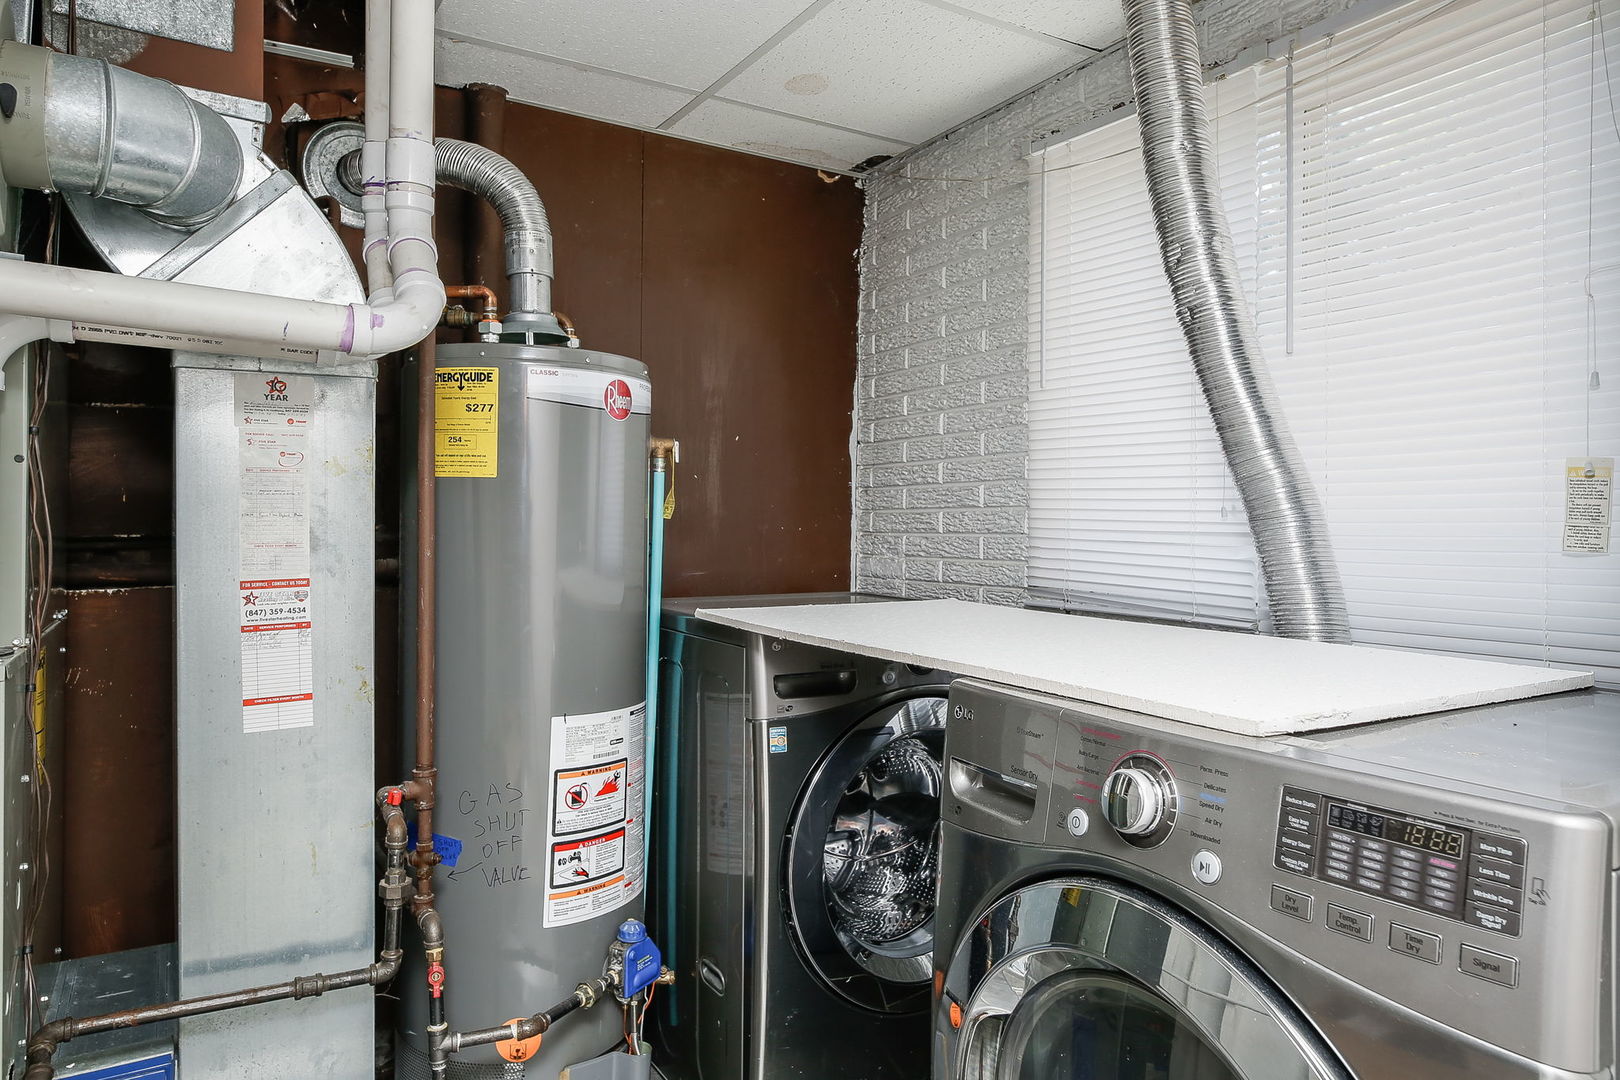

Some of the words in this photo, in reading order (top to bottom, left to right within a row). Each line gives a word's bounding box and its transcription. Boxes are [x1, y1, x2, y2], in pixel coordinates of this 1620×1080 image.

[606, 380, 632, 414] Rheem
[465, 404, 494, 412] $277
[245, 610, 266, 618] (847)
[269, 606, 306, 616] 359-4534
[588, 766, 612, 775] WARNING
[1010, 764, 1028, 777] Sensor
[1028, 770, 1038, 782] Dry
[1214, 768, 1229, 778] Press
[1204, 782, 1228, 794] Delicates
[458, 782, 523, 816] GAS
[1286, 796, 1302, 806] Reduce
[1302, 800, 1316, 808] Static
[1199, 800, 1214, 810] Speed
[1215, 804, 1224, 814] Dry
[474, 808, 531, 838] SHUT
[1205, 817, 1213, 825] Air
[1213, 819, 1222, 828] Dry
[584, 838, 606, 847] DANGER
[1190, 830, 1221, 845] Downloaded
[1282, 836, 1298, 846] Energy
[1298, 840, 1312, 850] Saver
[482, 835, 523, 858] OFF
[1480, 842, 1496, 852] More
[1496, 846, 1513, 856] Time
[1281, 855, 1298, 864] Custom
[1330, 860, 1340, 868] Less
[1340, 862, 1348, 870] Dry
[482, 865, 532, 888] VALVE
[1365, 870, 1376, 878] Low
[1479, 866, 1494, 876] Less
[1494, 870, 1510, 880] Time
[584, 884, 606, 893] WARNING
[1434, 889, 1446, 898] Low
[1284, 894, 1296, 904] Dry
[1472, 888, 1498, 902] Wrinkle
[1498, 896, 1514, 906] Care
[1282, 901, 1298, 912] Level
[1476, 910, 1494, 922] Damp
[1494, 915, 1508, 926] Dry
[1481, 918, 1502, 930] Signal
[1336, 920, 1360, 934] Control
[1404, 932, 1424, 946] Time
[1406, 942, 1420, 954] Dry
[1473, 957, 1500, 973] Signal
